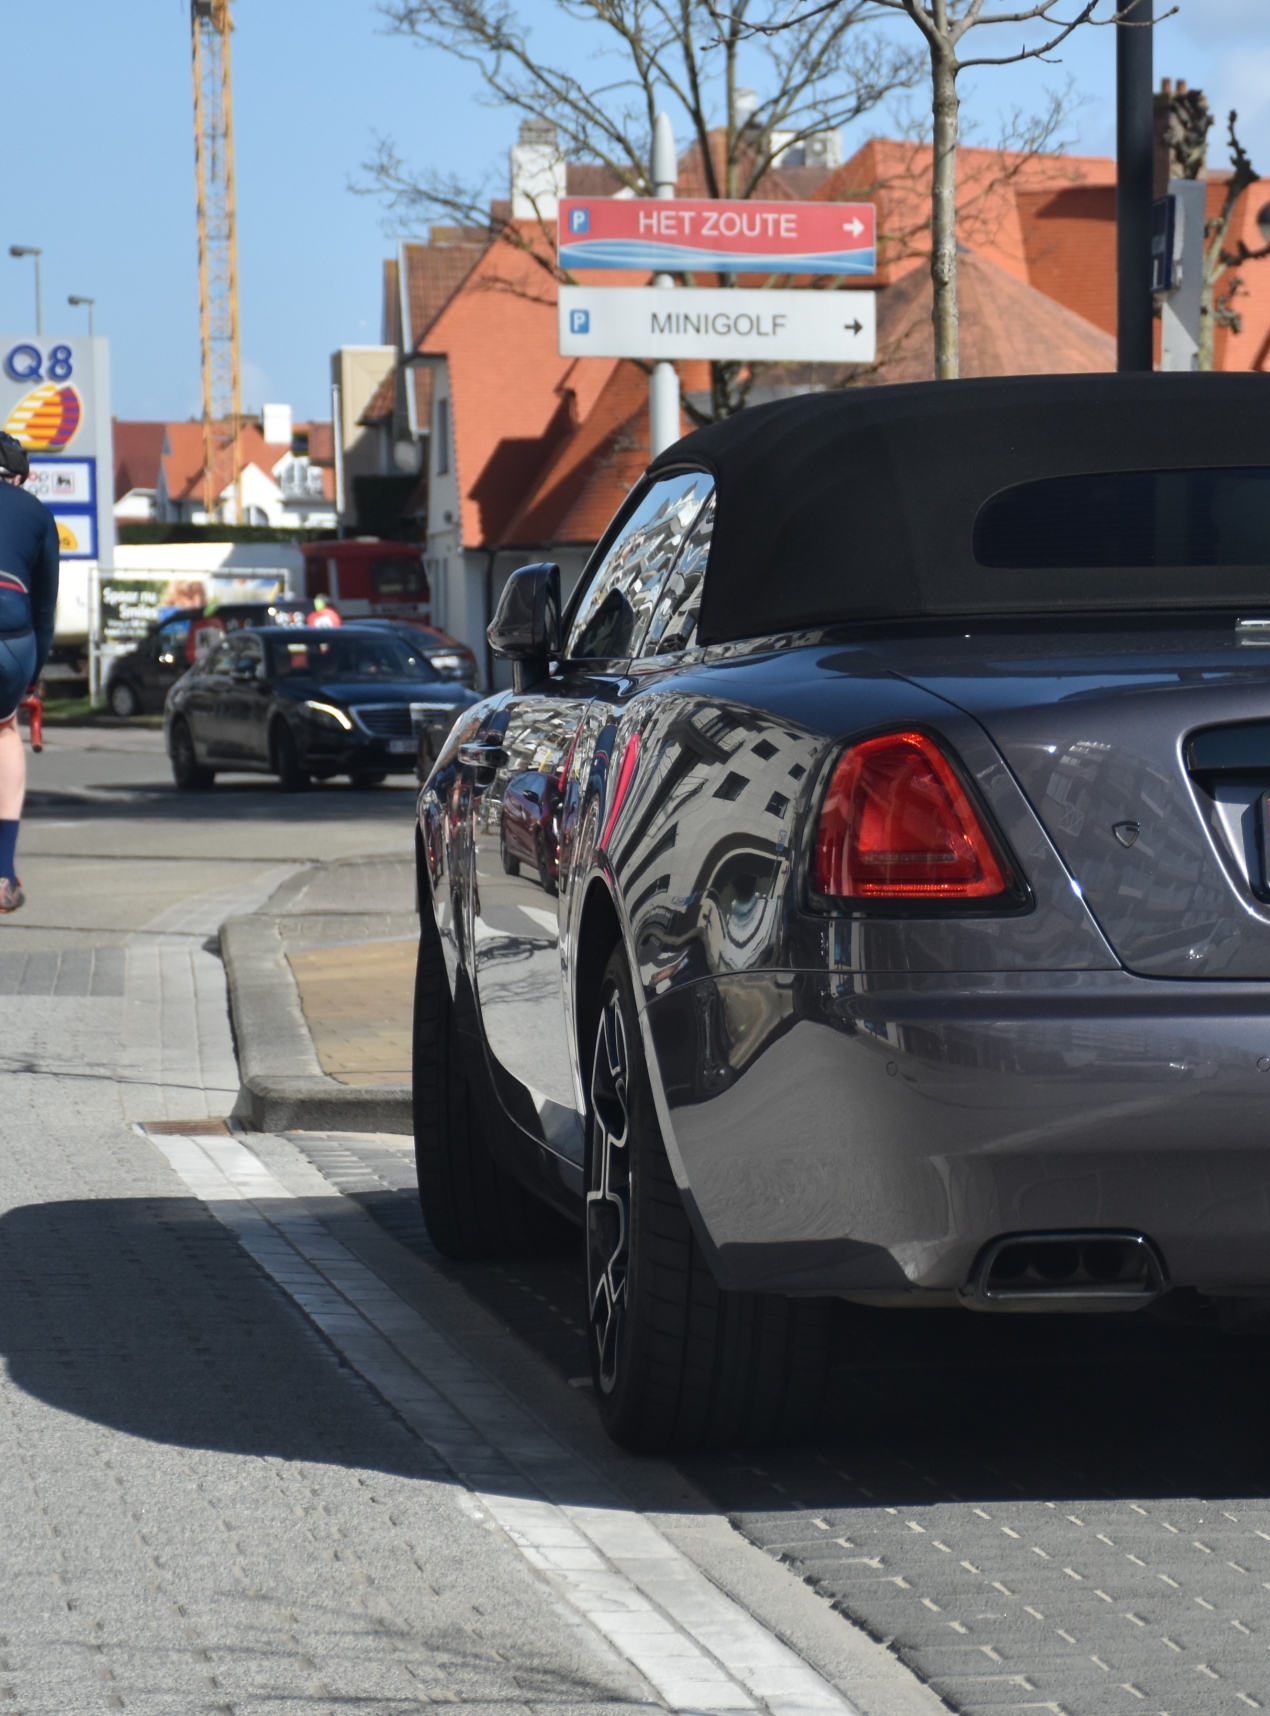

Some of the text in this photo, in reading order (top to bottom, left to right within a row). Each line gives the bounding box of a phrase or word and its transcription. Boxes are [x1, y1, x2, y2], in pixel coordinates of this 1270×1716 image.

[573, 211, 797, 238] P HET ZOUTE
[573, 312, 786, 336] P MINIGOLF
[6, 344, 73, 381] Q8
